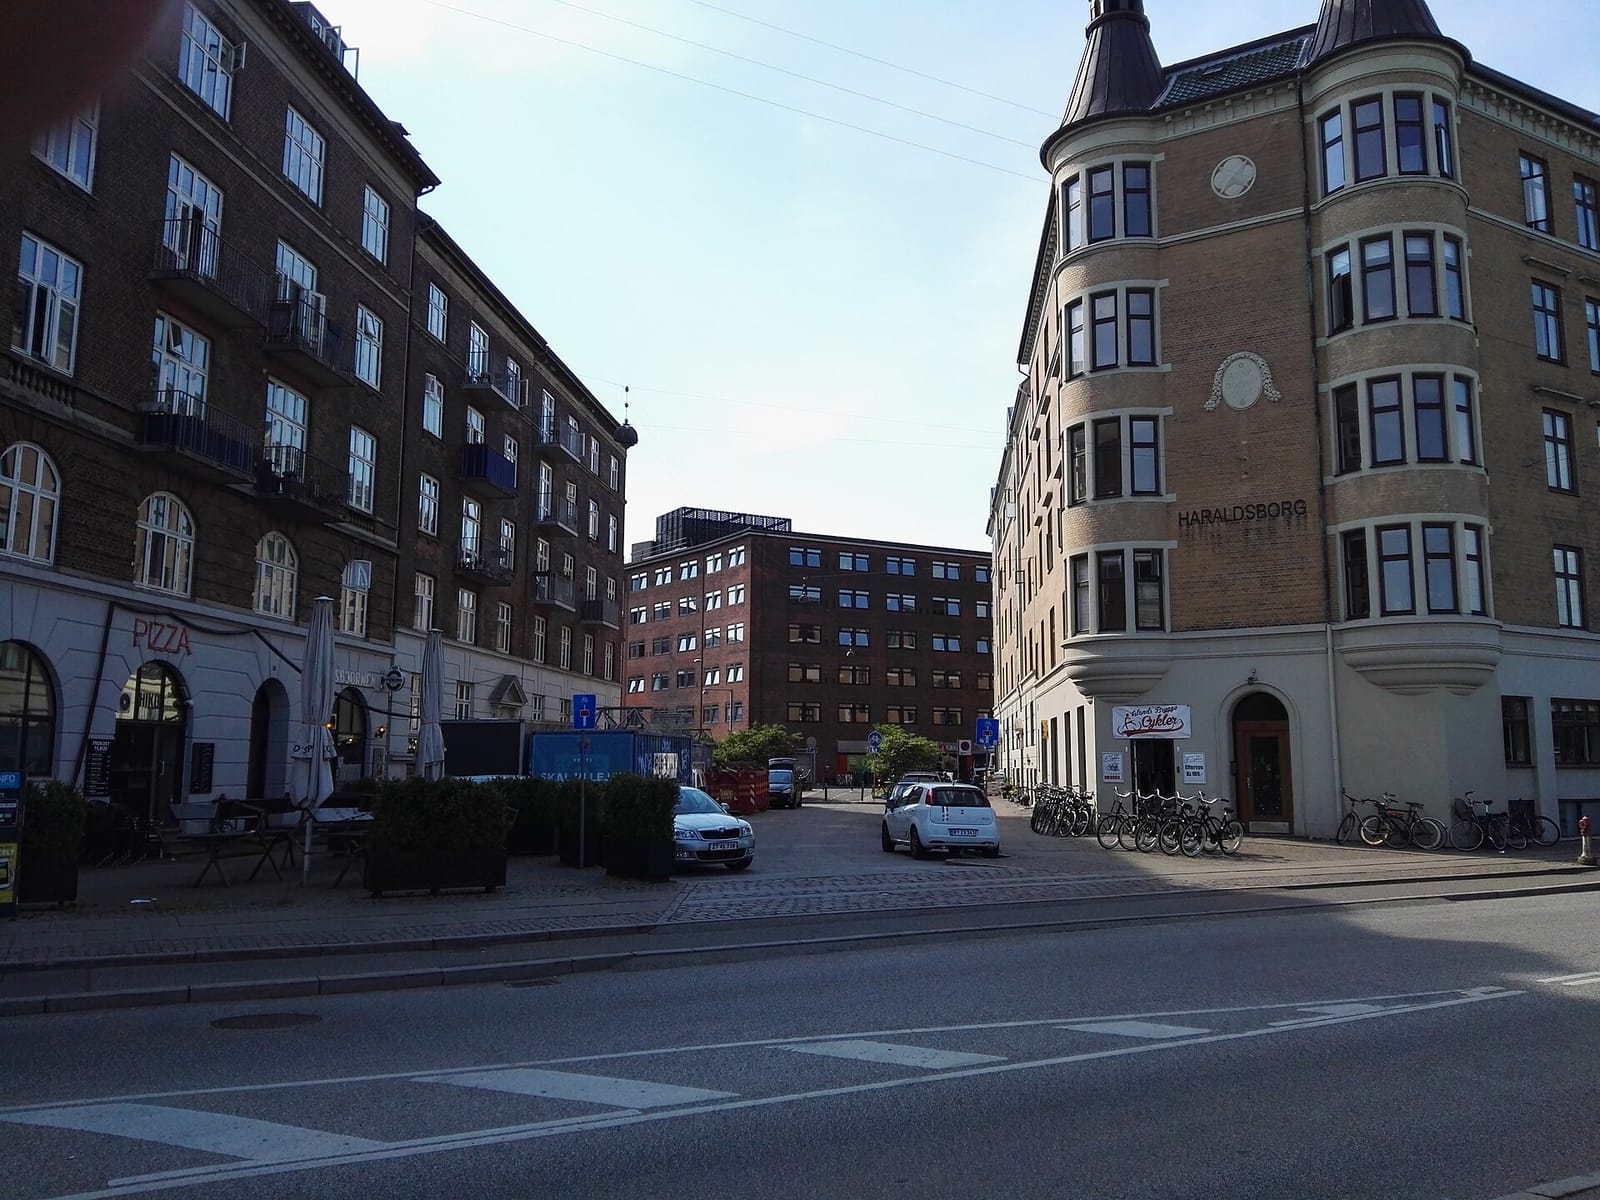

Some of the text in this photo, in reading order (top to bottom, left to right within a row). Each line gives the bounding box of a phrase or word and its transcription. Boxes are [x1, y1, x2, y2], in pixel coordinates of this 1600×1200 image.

[1178, 499, 1307, 527] HARALDSBORG
[132, 618, 192, 656] PIZZA
[1141, 713, 1179, 729] Cykler
